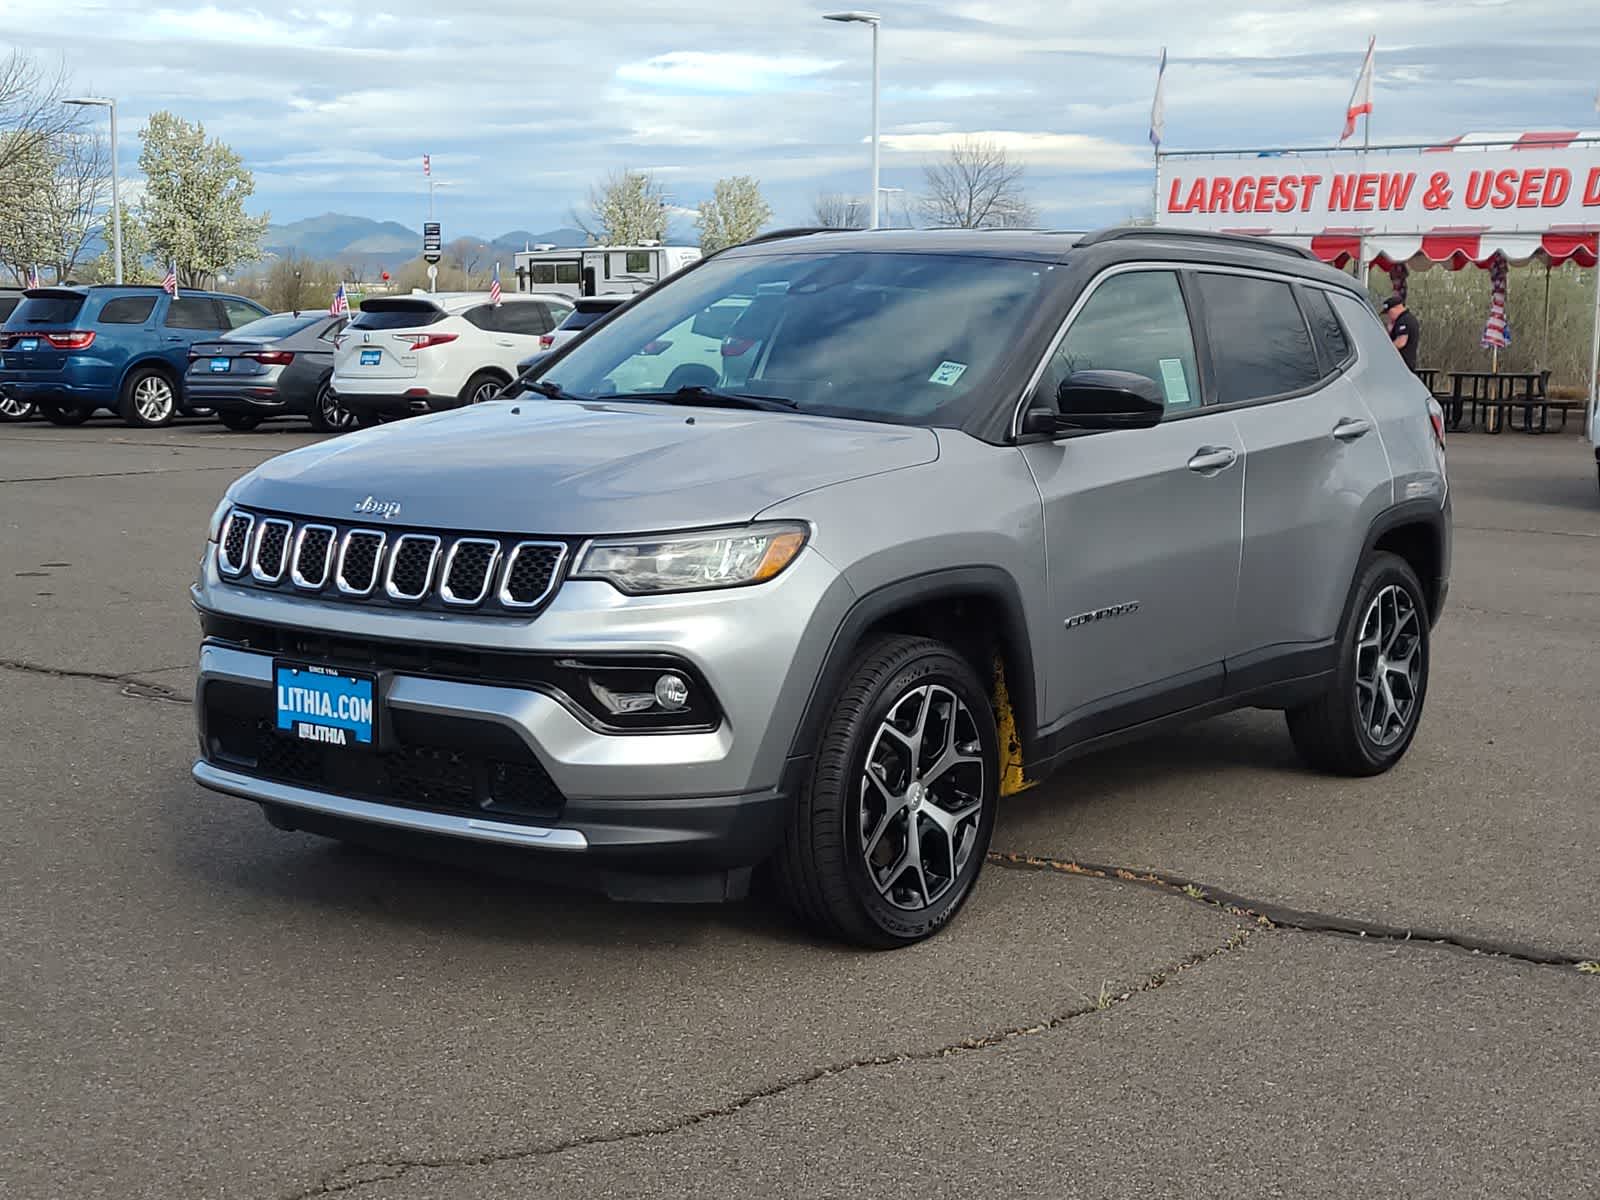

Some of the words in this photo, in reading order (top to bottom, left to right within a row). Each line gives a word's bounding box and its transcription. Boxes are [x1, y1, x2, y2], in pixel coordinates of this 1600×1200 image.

[1167, 175, 1323, 214] LARGEST
[1327, 172, 1416, 212] NEW
[1422, 171, 1453, 210] &
[1464, 168, 1572, 210] USED
[353, 496, 401, 519] Jeep
[1064, 601, 1139, 630] COMPASS
[278, 686, 372, 724] LITHIA.COM
[309, 723, 347, 745] LITHIA
